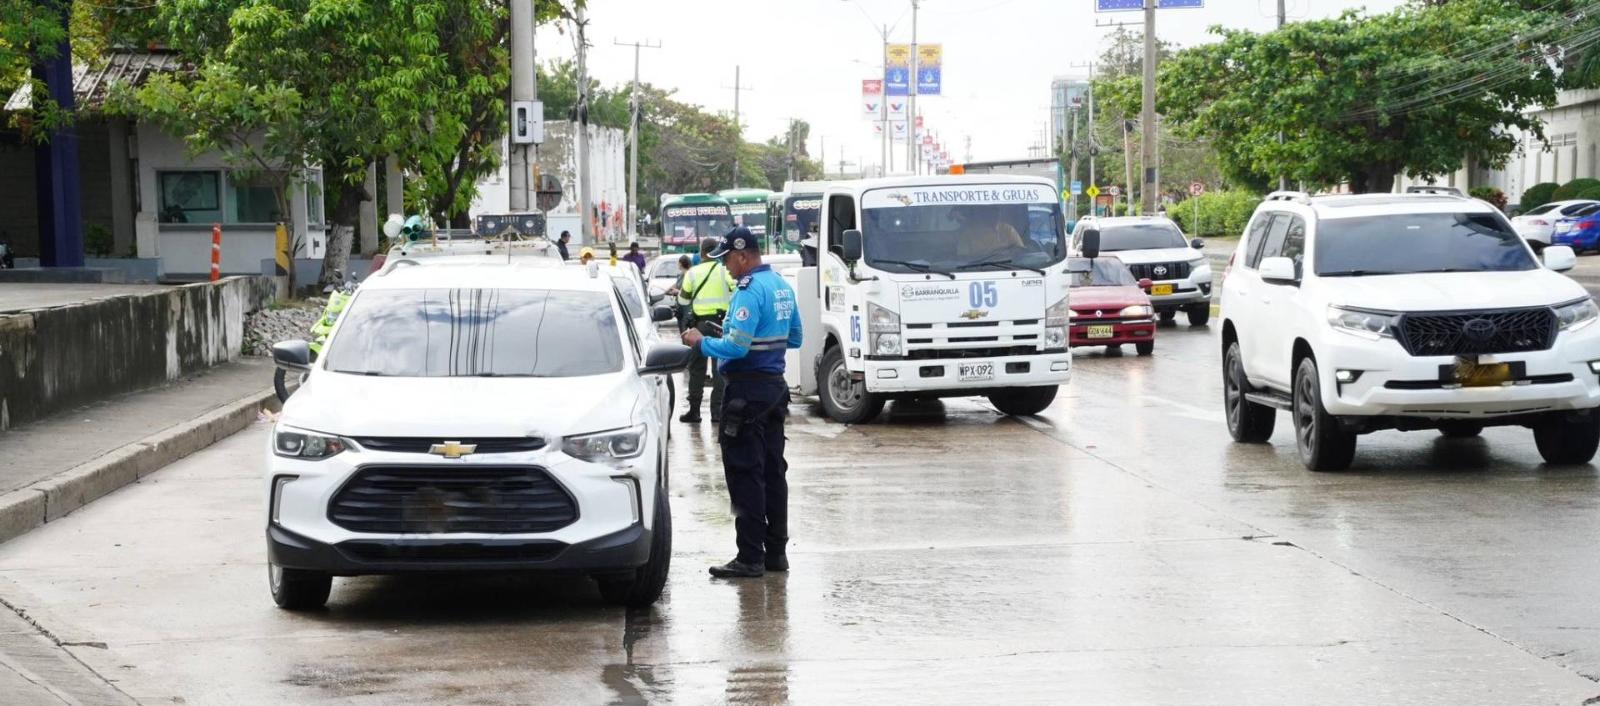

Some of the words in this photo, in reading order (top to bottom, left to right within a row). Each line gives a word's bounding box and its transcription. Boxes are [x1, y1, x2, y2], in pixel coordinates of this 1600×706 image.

[913, 189, 990, 204] TRANSPORTE
[991, 189, 1001, 202] &
[1002, 188, 1040, 202] GRUAS
[914, 288, 960, 297] BARRANQUILLA
[968, 280, 998, 309] 05
[849, 315, 862, 343] 05
